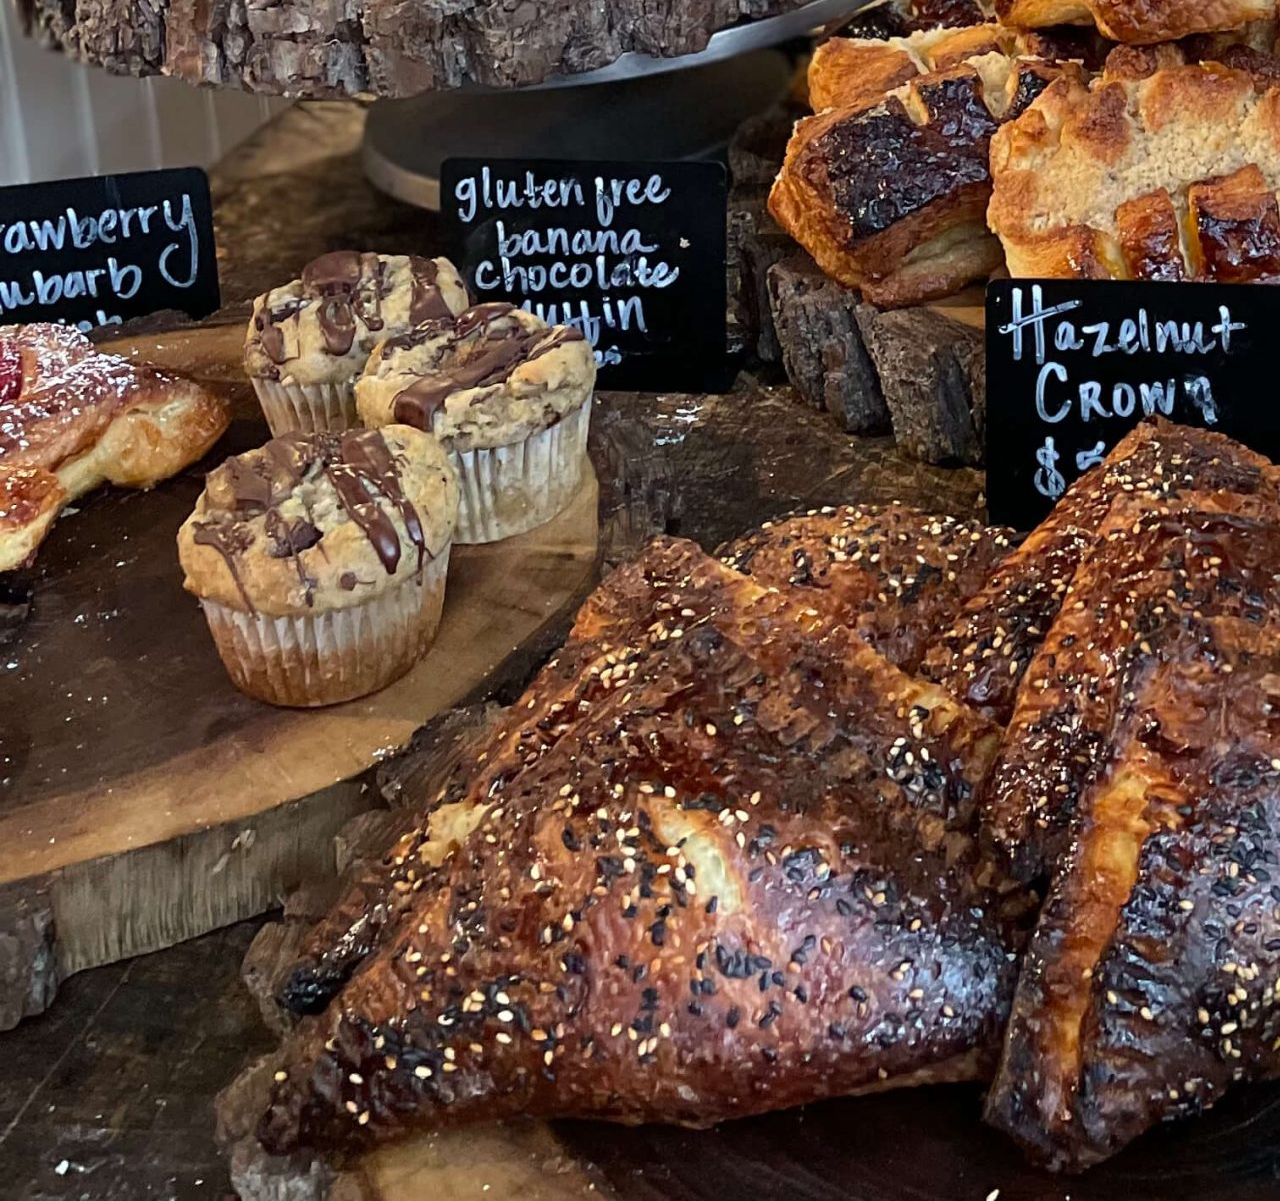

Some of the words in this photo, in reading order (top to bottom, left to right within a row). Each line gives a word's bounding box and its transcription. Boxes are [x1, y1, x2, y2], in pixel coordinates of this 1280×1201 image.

[454, 165, 585, 223] gluten
[594, 174, 672, 227] free
[0, 193, 200, 288] awberry
[495, 220, 661, 258] banana
[0, 256, 143, 315] ubarb
[474, 254, 681, 295] chocolate
[517, 295, 649, 348] uffin
[998, 284, 1249, 365] Hazelnut
